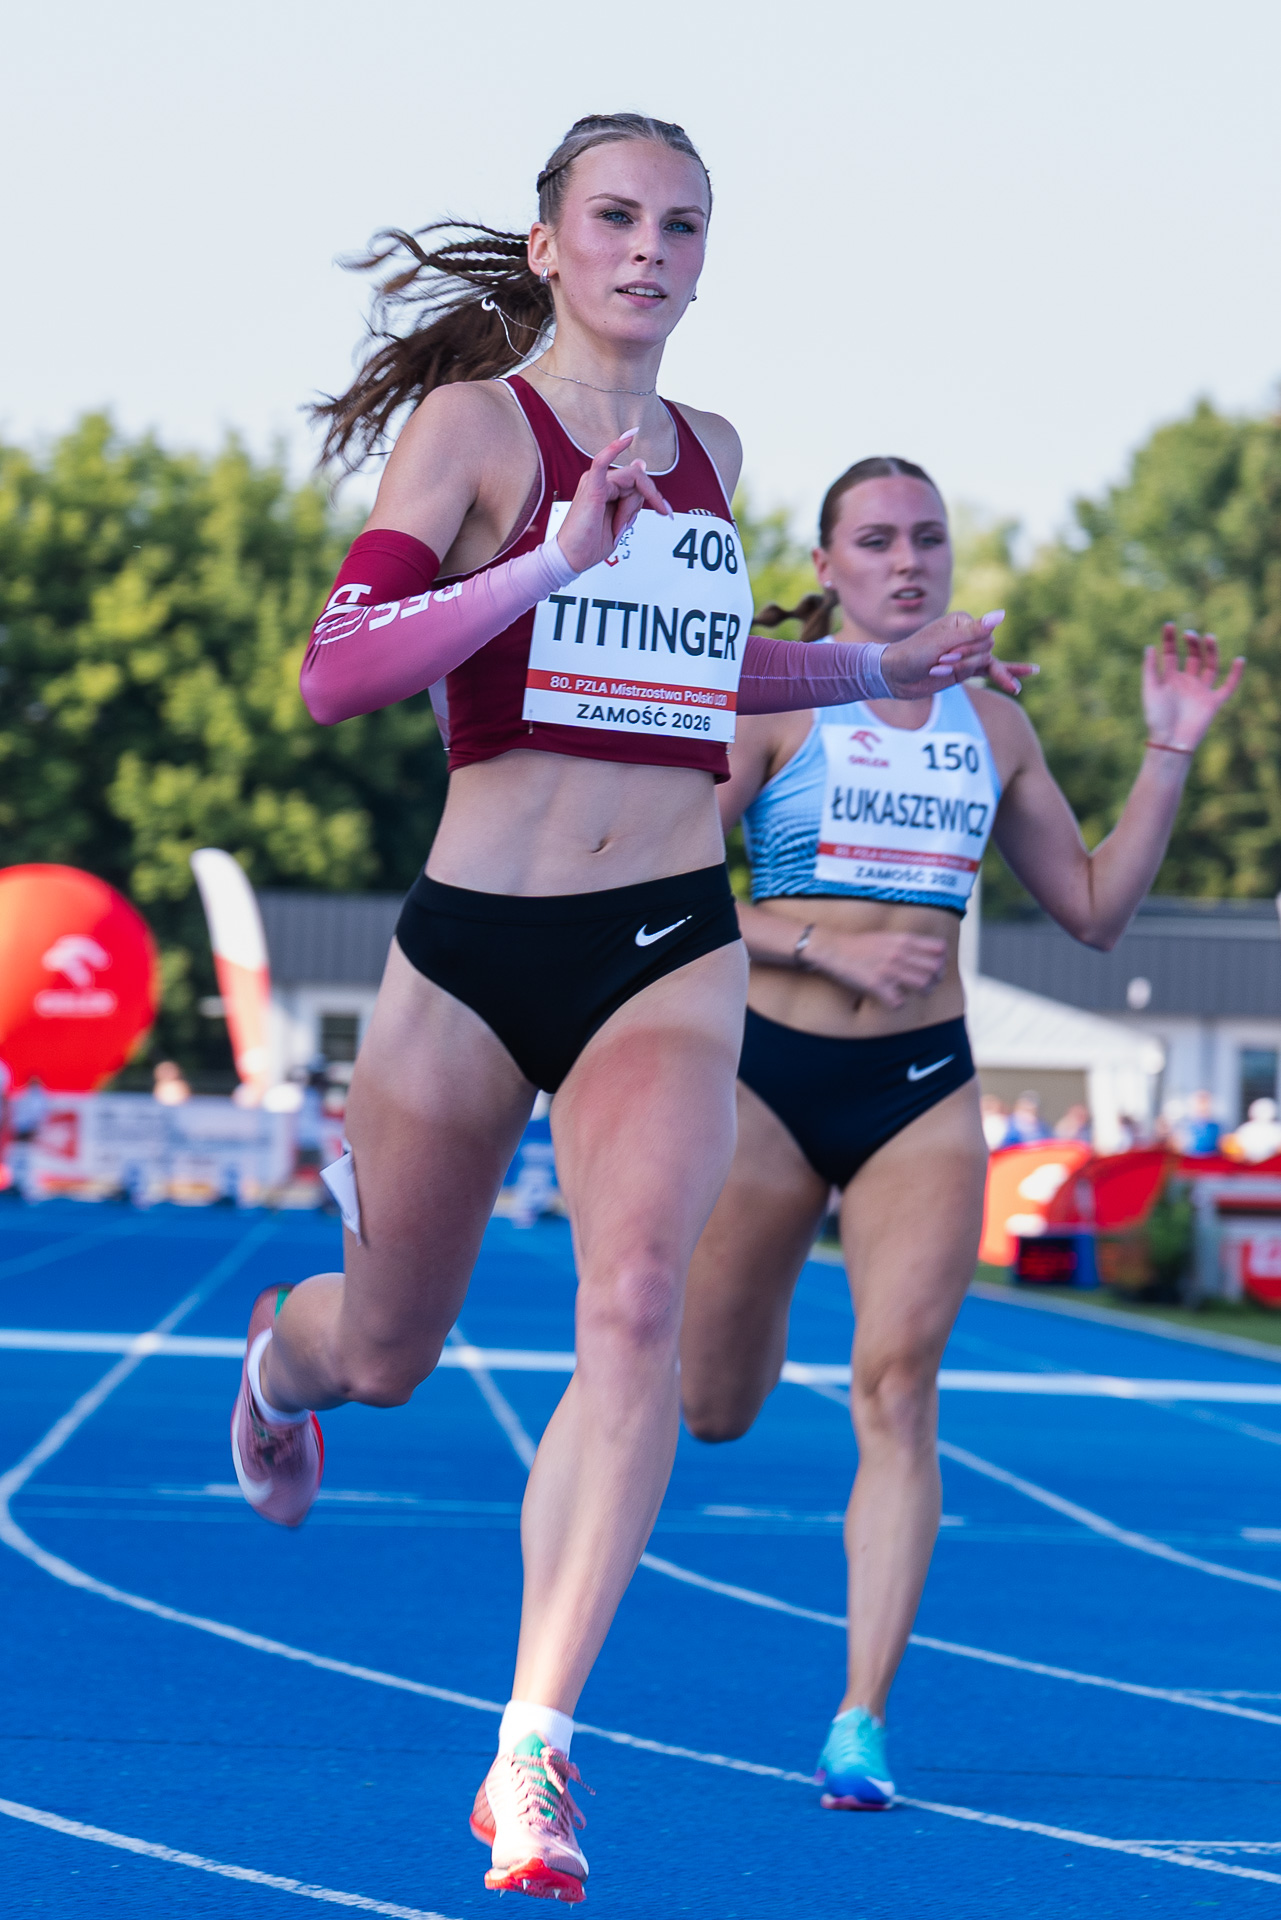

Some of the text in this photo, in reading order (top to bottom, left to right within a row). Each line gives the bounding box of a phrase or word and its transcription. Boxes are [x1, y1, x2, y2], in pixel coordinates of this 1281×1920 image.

[672, 528, 738, 575] 408
[548, 593, 741, 661] TITTINGER
[550, 675, 573, 690] 80.
[575, 680, 608, 695] PZLA
[610, 683, 683, 702] Mistrzostwa
[576, 703, 711, 732] ZAMOŚĆ 2026
[922, 743, 980, 774] 150
